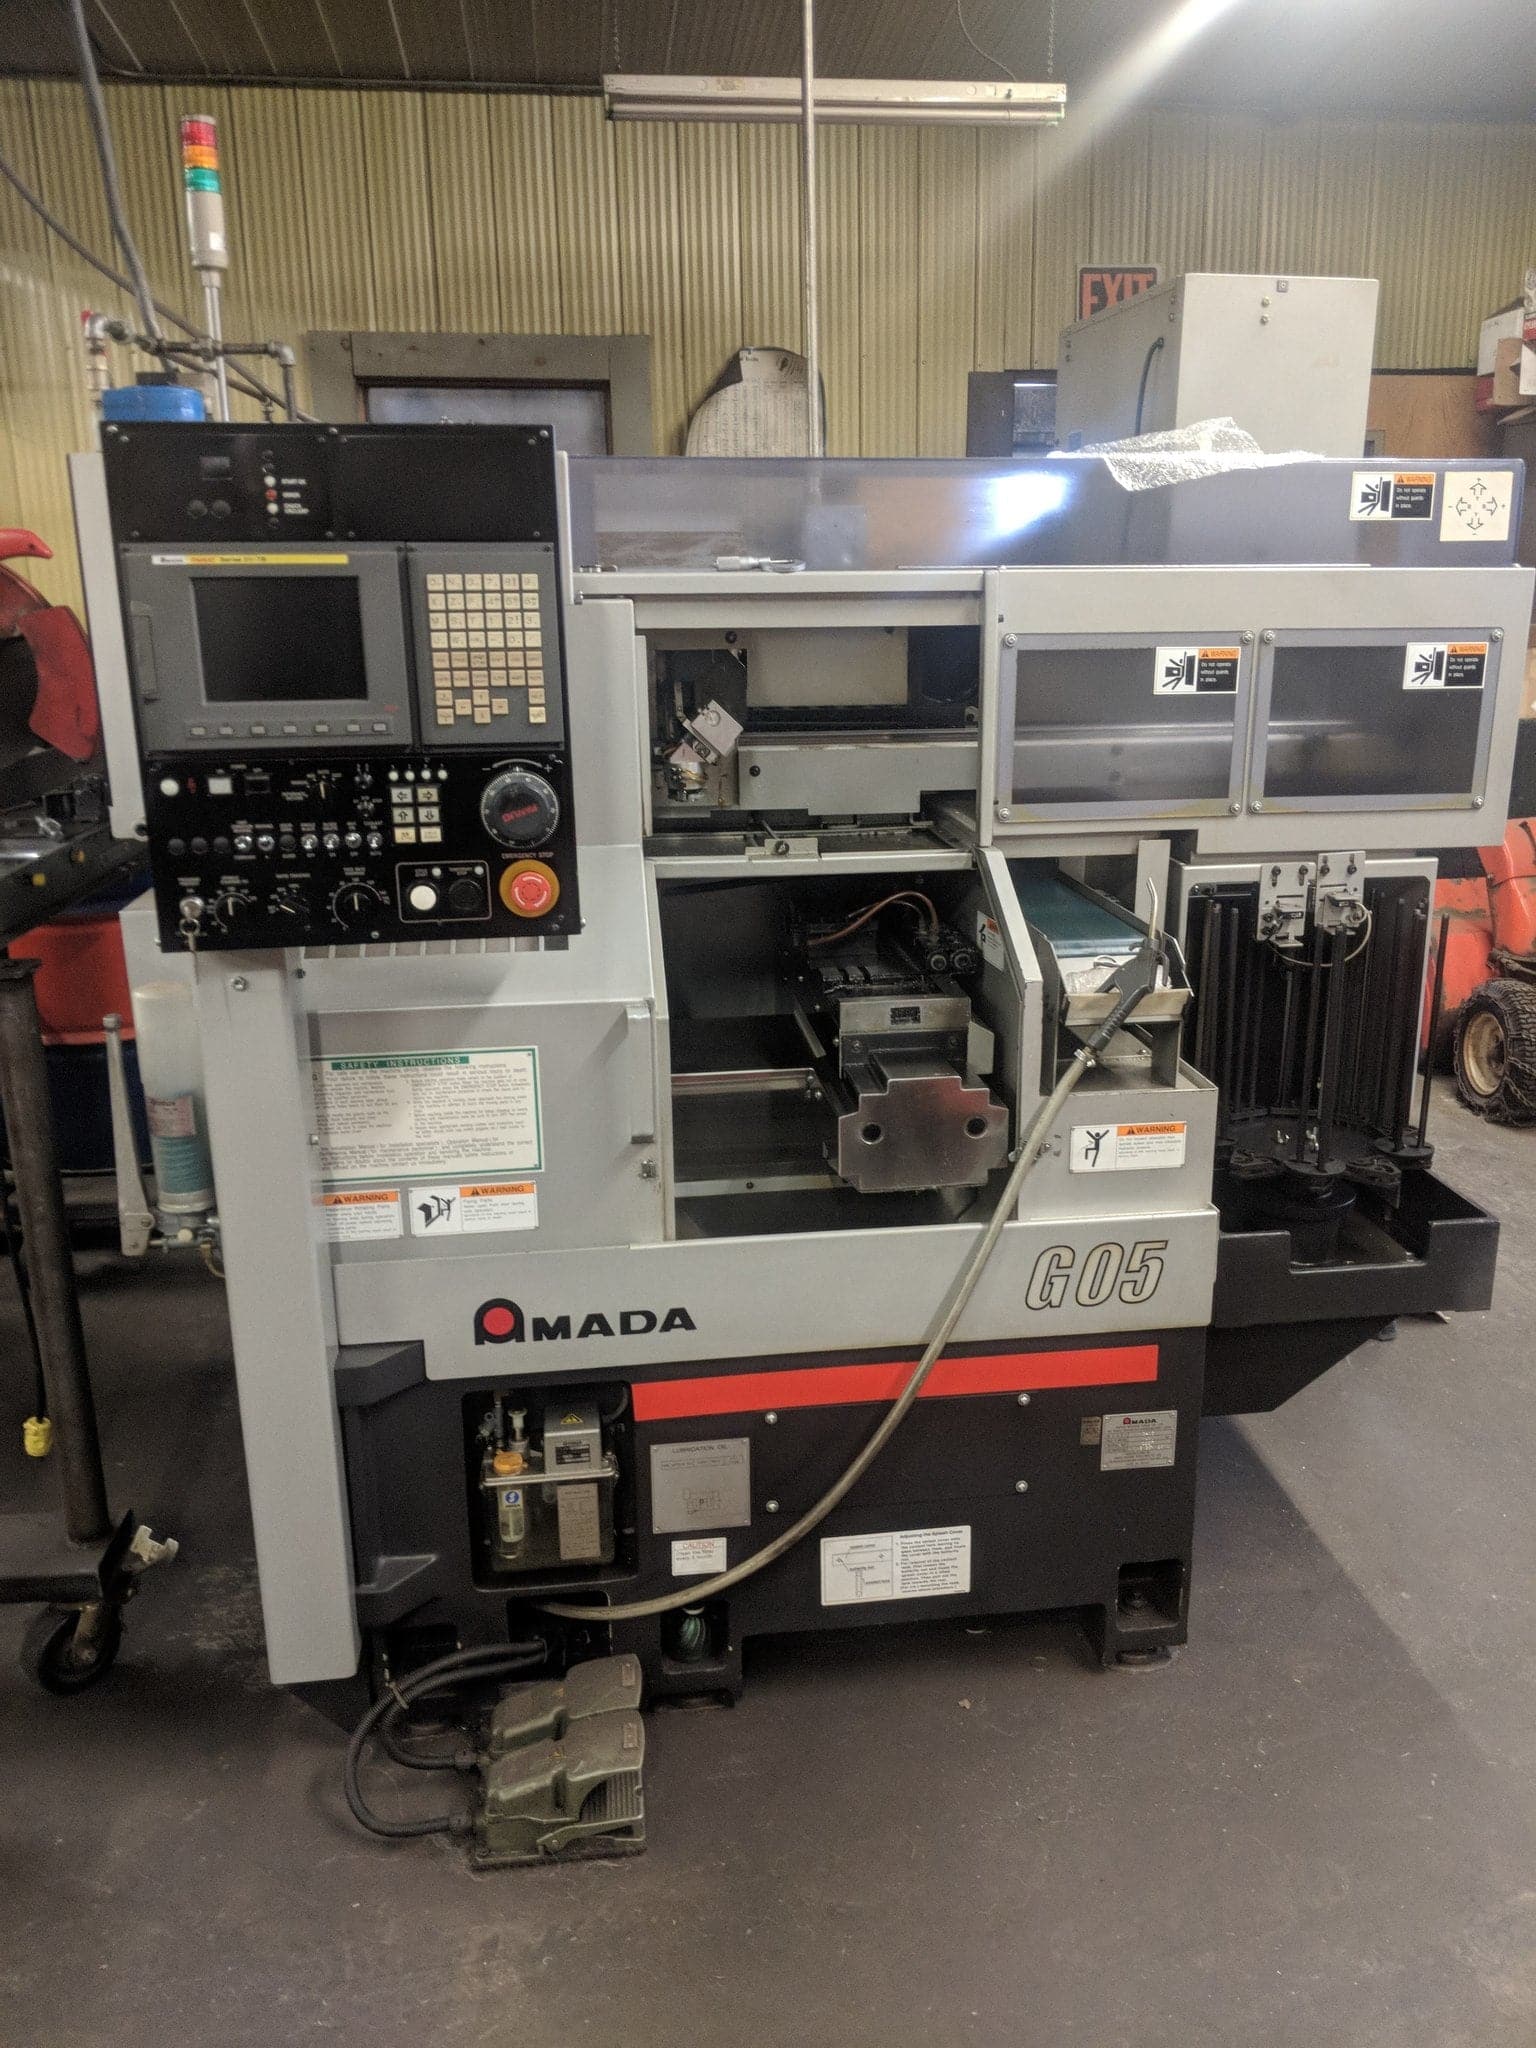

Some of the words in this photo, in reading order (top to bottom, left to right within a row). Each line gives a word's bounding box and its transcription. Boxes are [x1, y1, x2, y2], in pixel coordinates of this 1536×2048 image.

[1082, 273, 1154, 320] EXIT
[340, 1061, 379, 1069] SAFETY
[386, 1056, 463, 1068] INSTRUCTIONS
[1135, 1124, 1177, 1135] WARNING
[480, 1184, 525, 1195] WARNING
[343, 1193, 389, 1204] WARNING
[474, 1297, 698, 1346] AMADA
[672, 1444, 714, 1454] LUBRICATION
